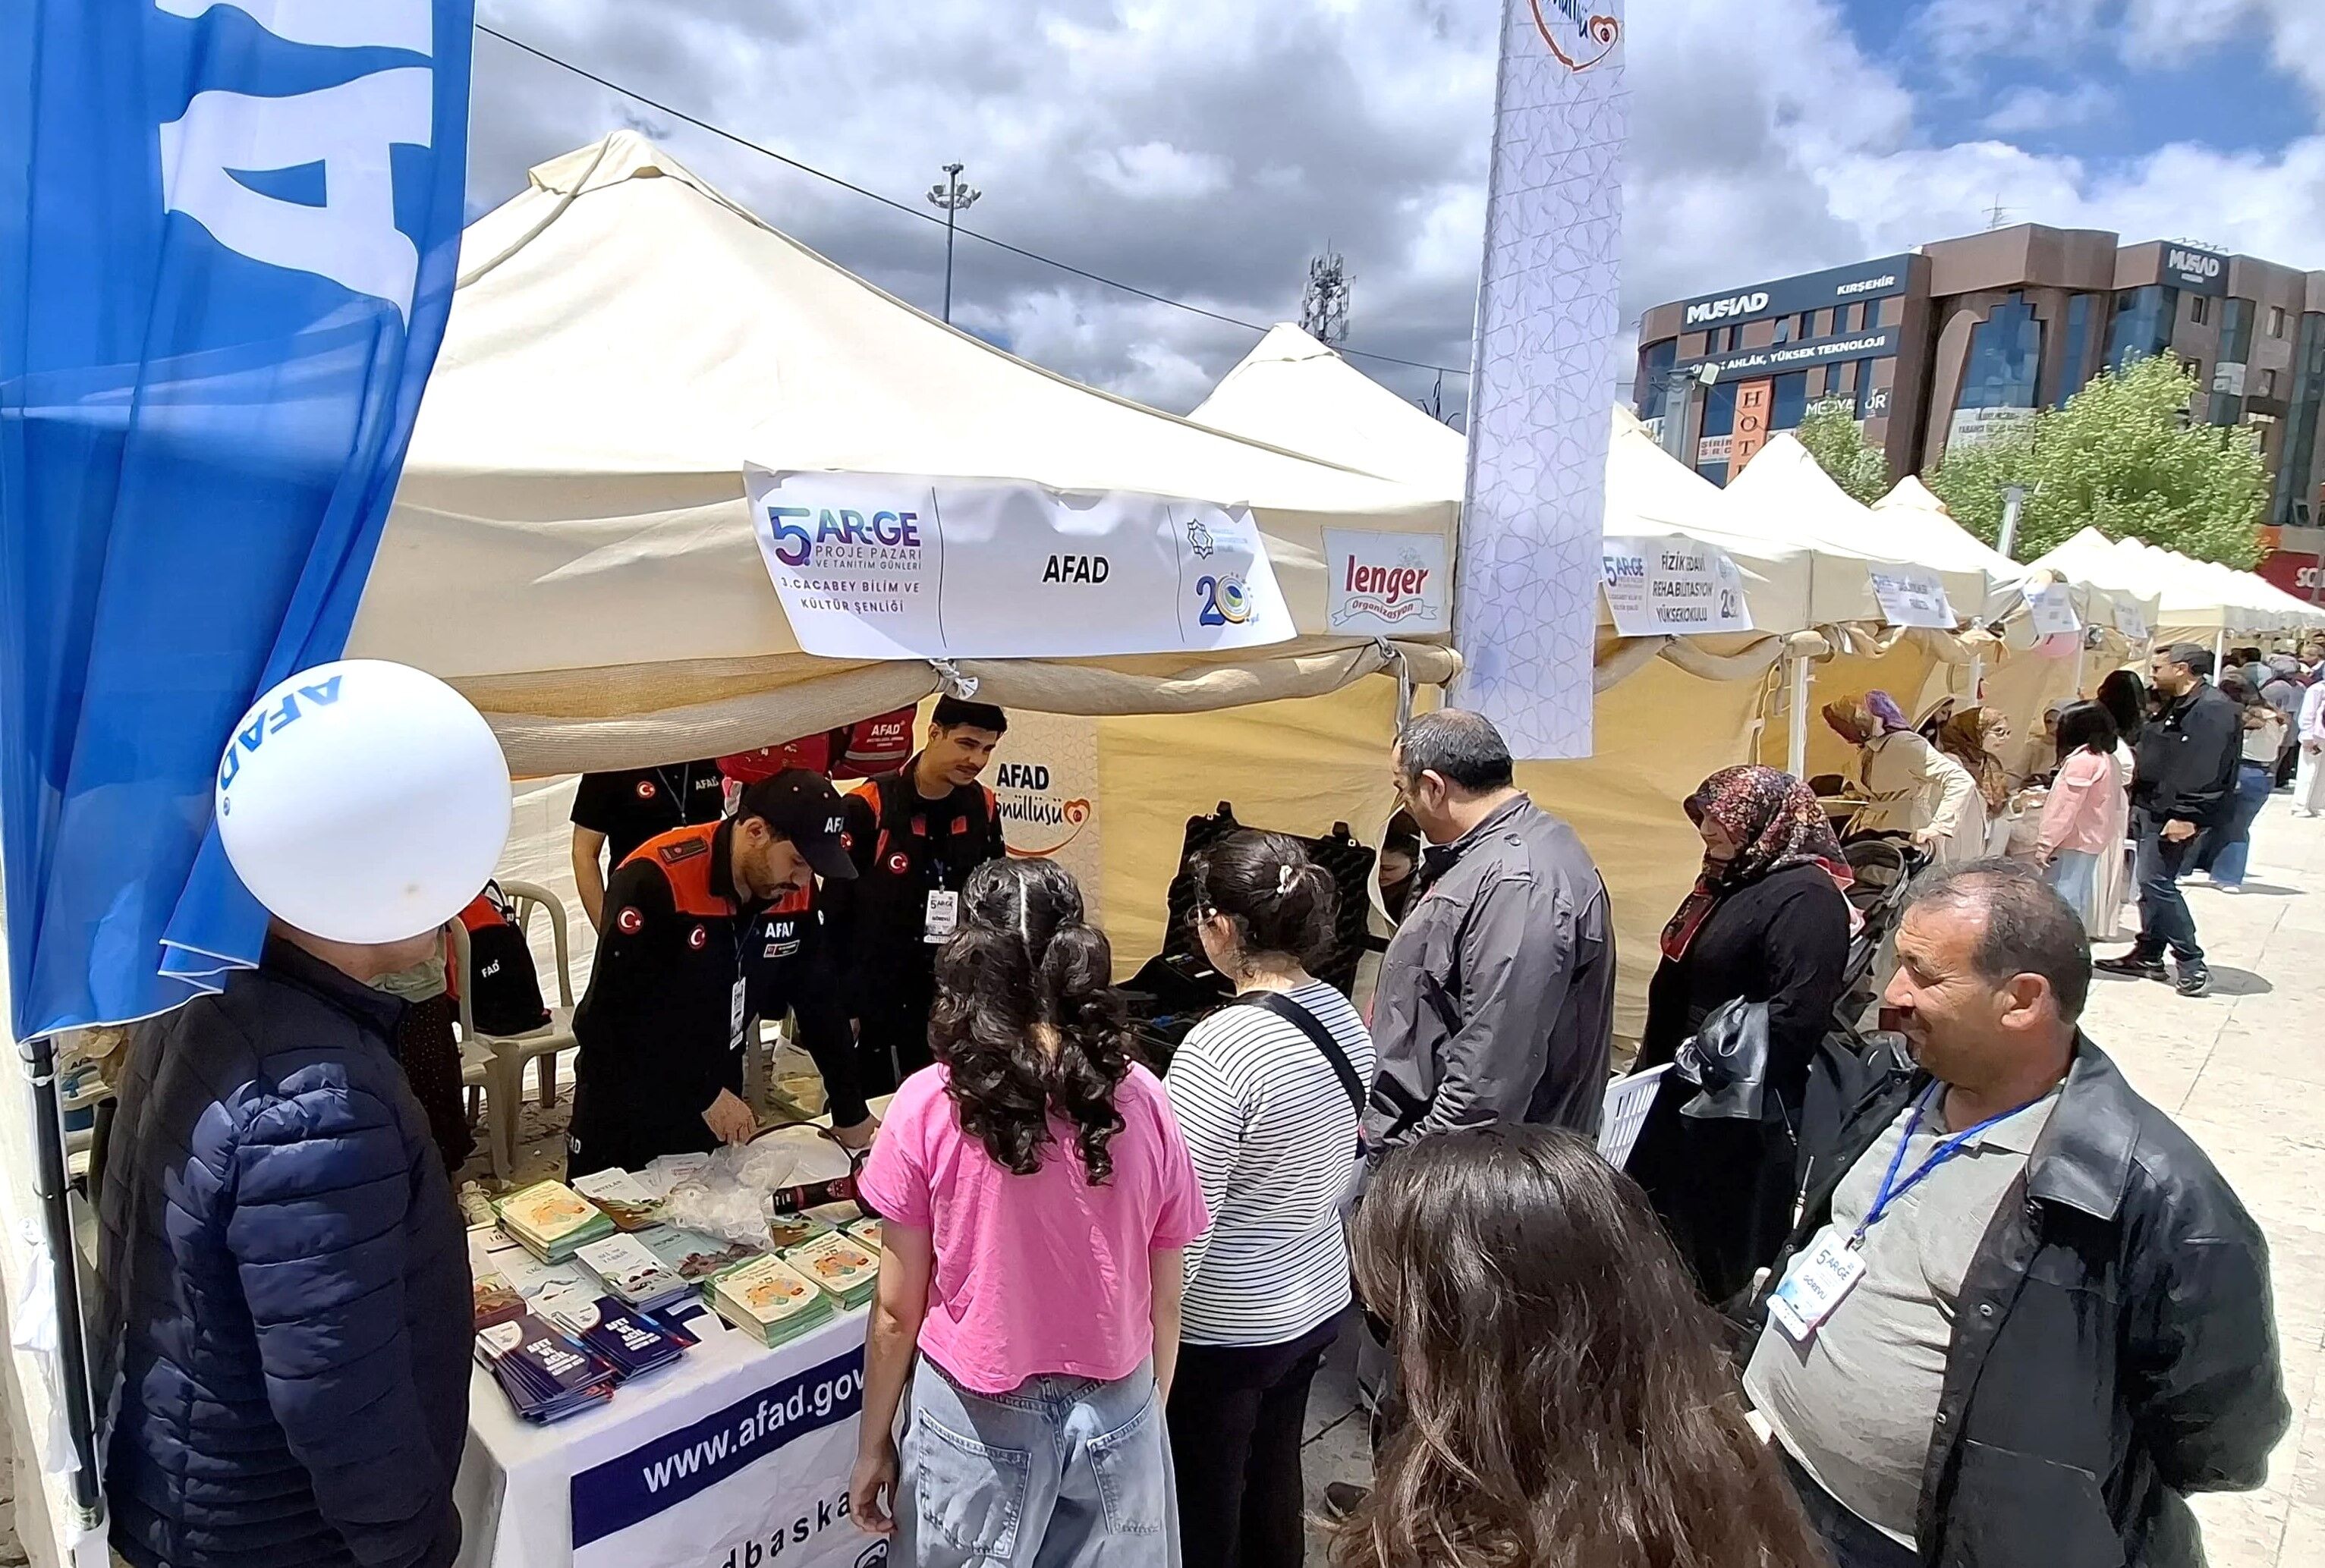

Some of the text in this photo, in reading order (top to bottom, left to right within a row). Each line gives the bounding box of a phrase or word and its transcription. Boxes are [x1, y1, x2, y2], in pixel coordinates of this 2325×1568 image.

[1837, 275, 1896, 295] KIRŞEHİR
[1770, 347, 1816, 363] YÜKSEK
[816, 509, 920, 547] AR-GE
[816, 545, 922, 560] PROJE PAZARI
[1661, 551, 1685, 571] FİZİK
[816, 560, 922, 570] VE TANITIM GÜNLERİ
[1042, 555, 1109, 585] AFAD
[862, 579, 898, 592] BİLİM
[905, 582, 920, 592] VE
[1345, 555, 1430, 604] lenger
[801, 598, 904, 614] KÜLTÜR ŞENLİĞİ
[219, 674, 343, 791] AFAD
[870, 723, 901, 737] AFAD
[996, 763, 1049, 790] AFAD
